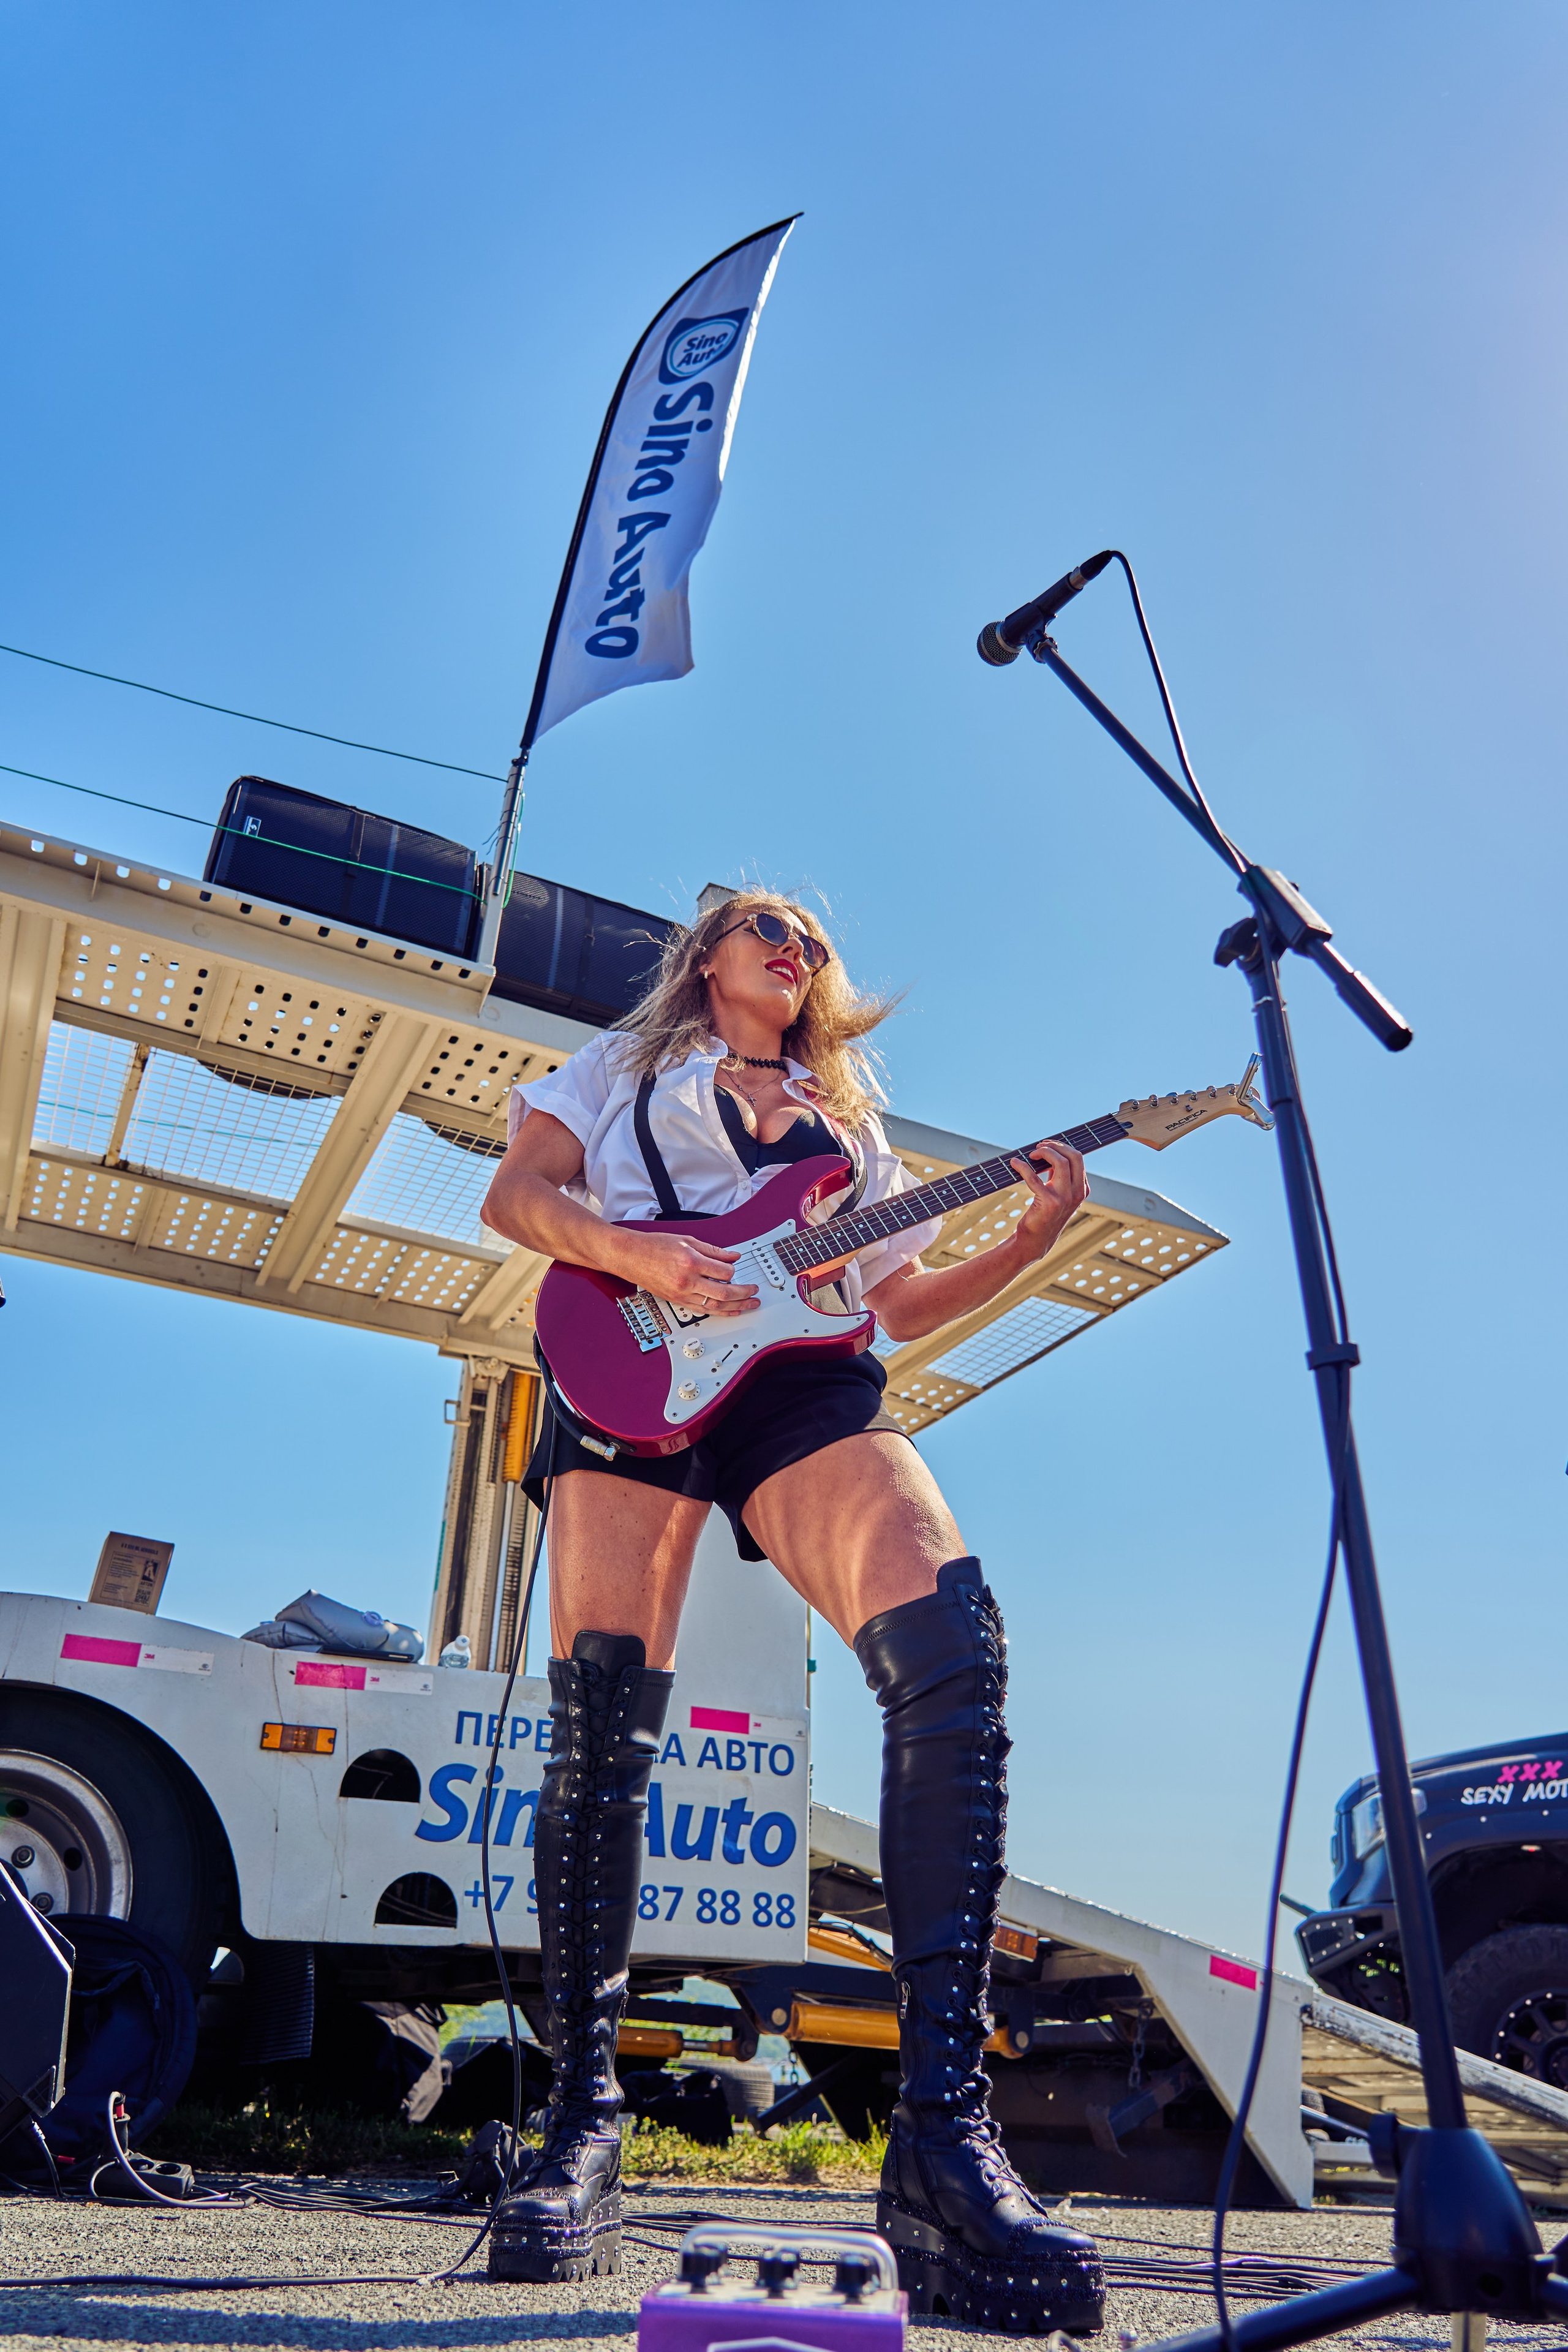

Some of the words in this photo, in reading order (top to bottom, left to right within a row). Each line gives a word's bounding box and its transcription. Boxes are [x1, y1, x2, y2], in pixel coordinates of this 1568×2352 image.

[683, 333, 728, 353] Sino
[627, 381, 715, 502] Sino
[584, 511, 672, 660] Auto
[1165, 1109, 1208, 1130] PACIFICA
[455, 1711, 687, 1766] ПЕРЕА
[697, 1736, 794, 1776] АВТО
[414, 1763, 541, 1848] Sin
[1460, 1782, 1514, 1805] SEXY
[464, 1875, 514, 1912] +7
[638, 1884, 684, 1921] 87
[696, 1888, 741, 1925] 88
[752, 1891, 796, 1929] 88
